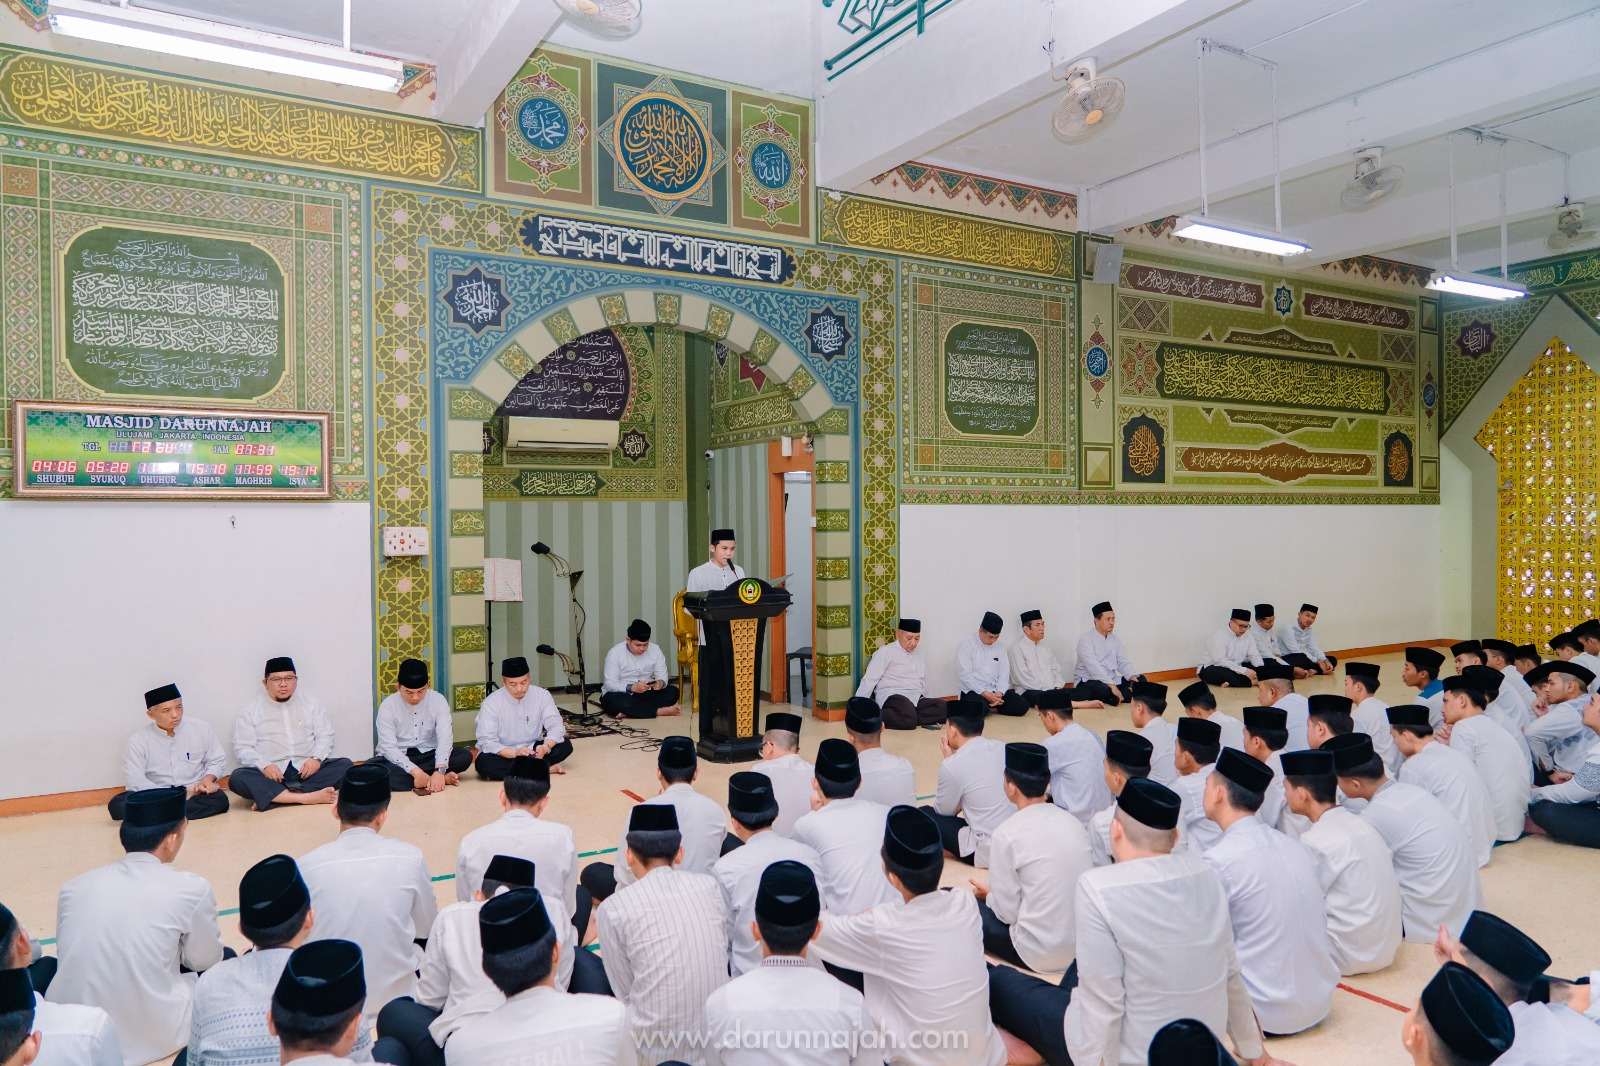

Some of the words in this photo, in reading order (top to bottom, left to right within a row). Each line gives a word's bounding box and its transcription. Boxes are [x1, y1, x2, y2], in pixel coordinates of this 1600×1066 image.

[86, 415, 153, 429] MASJID
[160, 417, 272, 433] DARUNNAJAH
[116, 431, 153, 439] ULUJAMI
[160, 432, 196, 441] JAKARTA
[202, 433, 245, 442] INDONESIA
[32, 459, 77, 474] 04:06
[37, 474, 75, 483] SHUBUH
[90, 475, 127, 485] SYURUQ
[140, 475, 177, 484] DHUHUR
[193, 477, 221, 485] ASHAR
[235, 477, 273, 486] MAGHRIB
